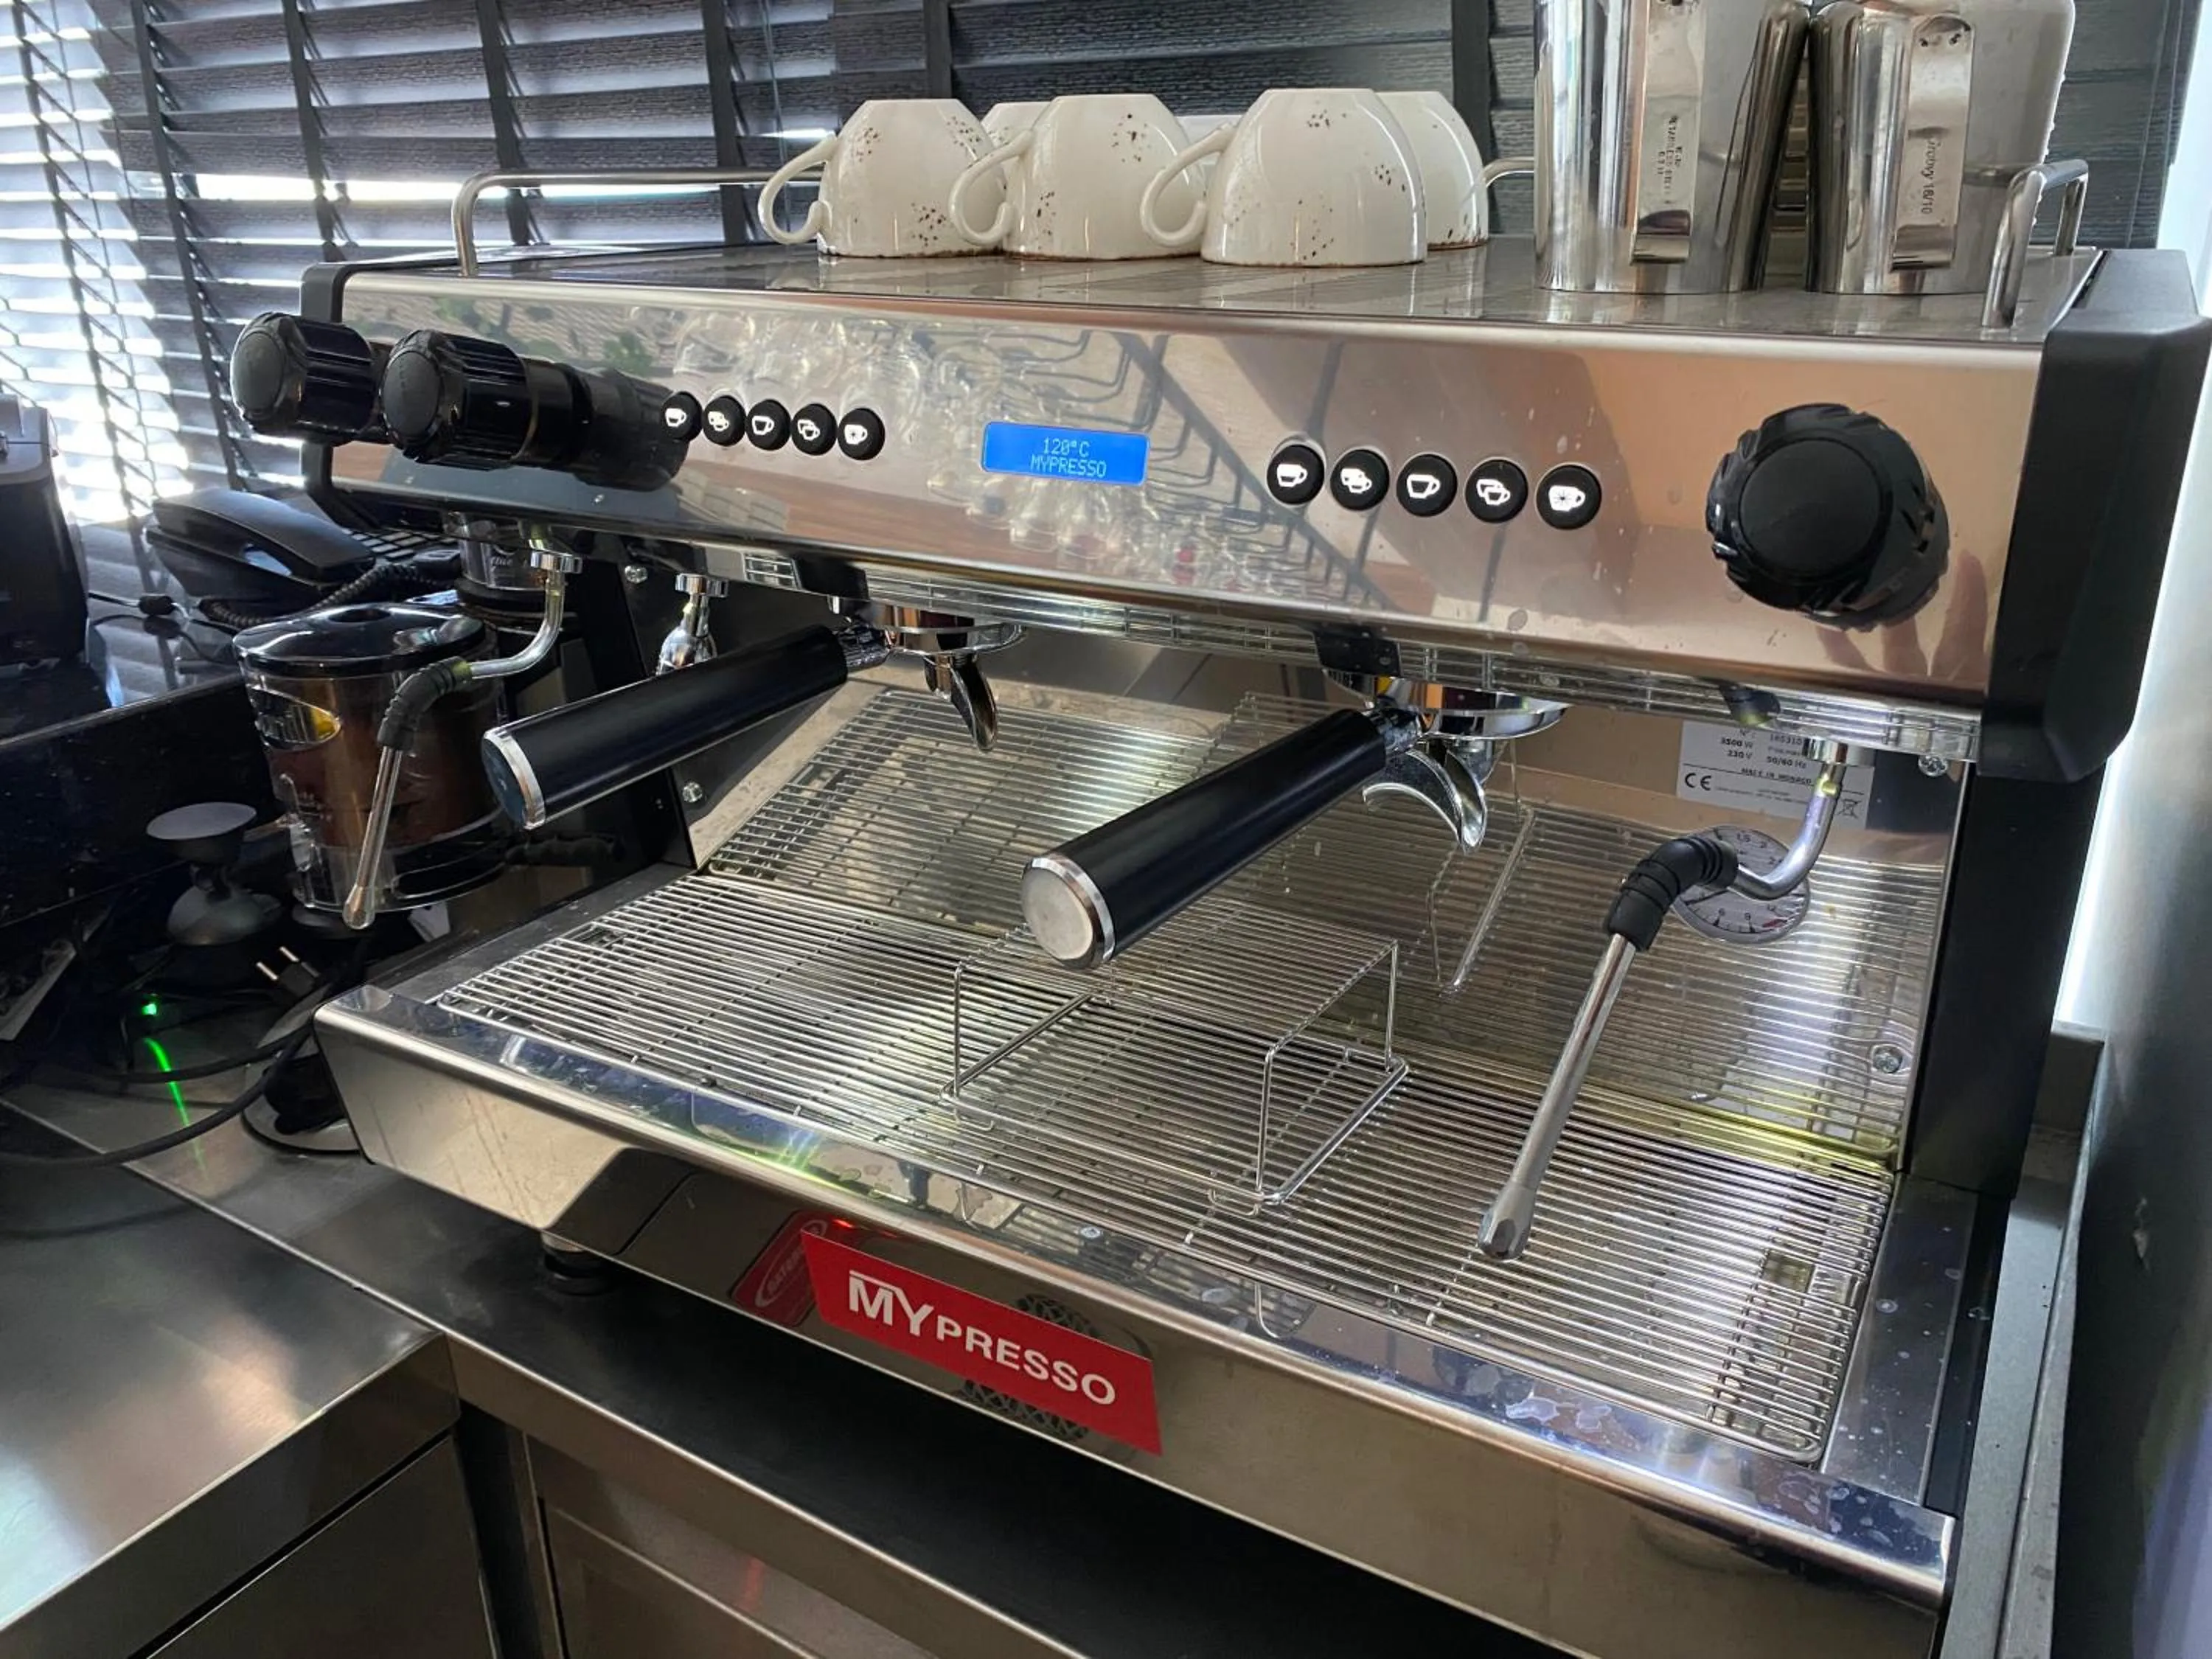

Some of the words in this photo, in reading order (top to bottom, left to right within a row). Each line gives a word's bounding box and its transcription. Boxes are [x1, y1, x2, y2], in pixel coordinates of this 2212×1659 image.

[1043, 437, 1090, 458] 120°C
[1030, 453, 1107, 478] MYPRESSO
[1684, 772, 1712, 791] CE
[849, 1269, 1116, 1405] MYPRESSO
